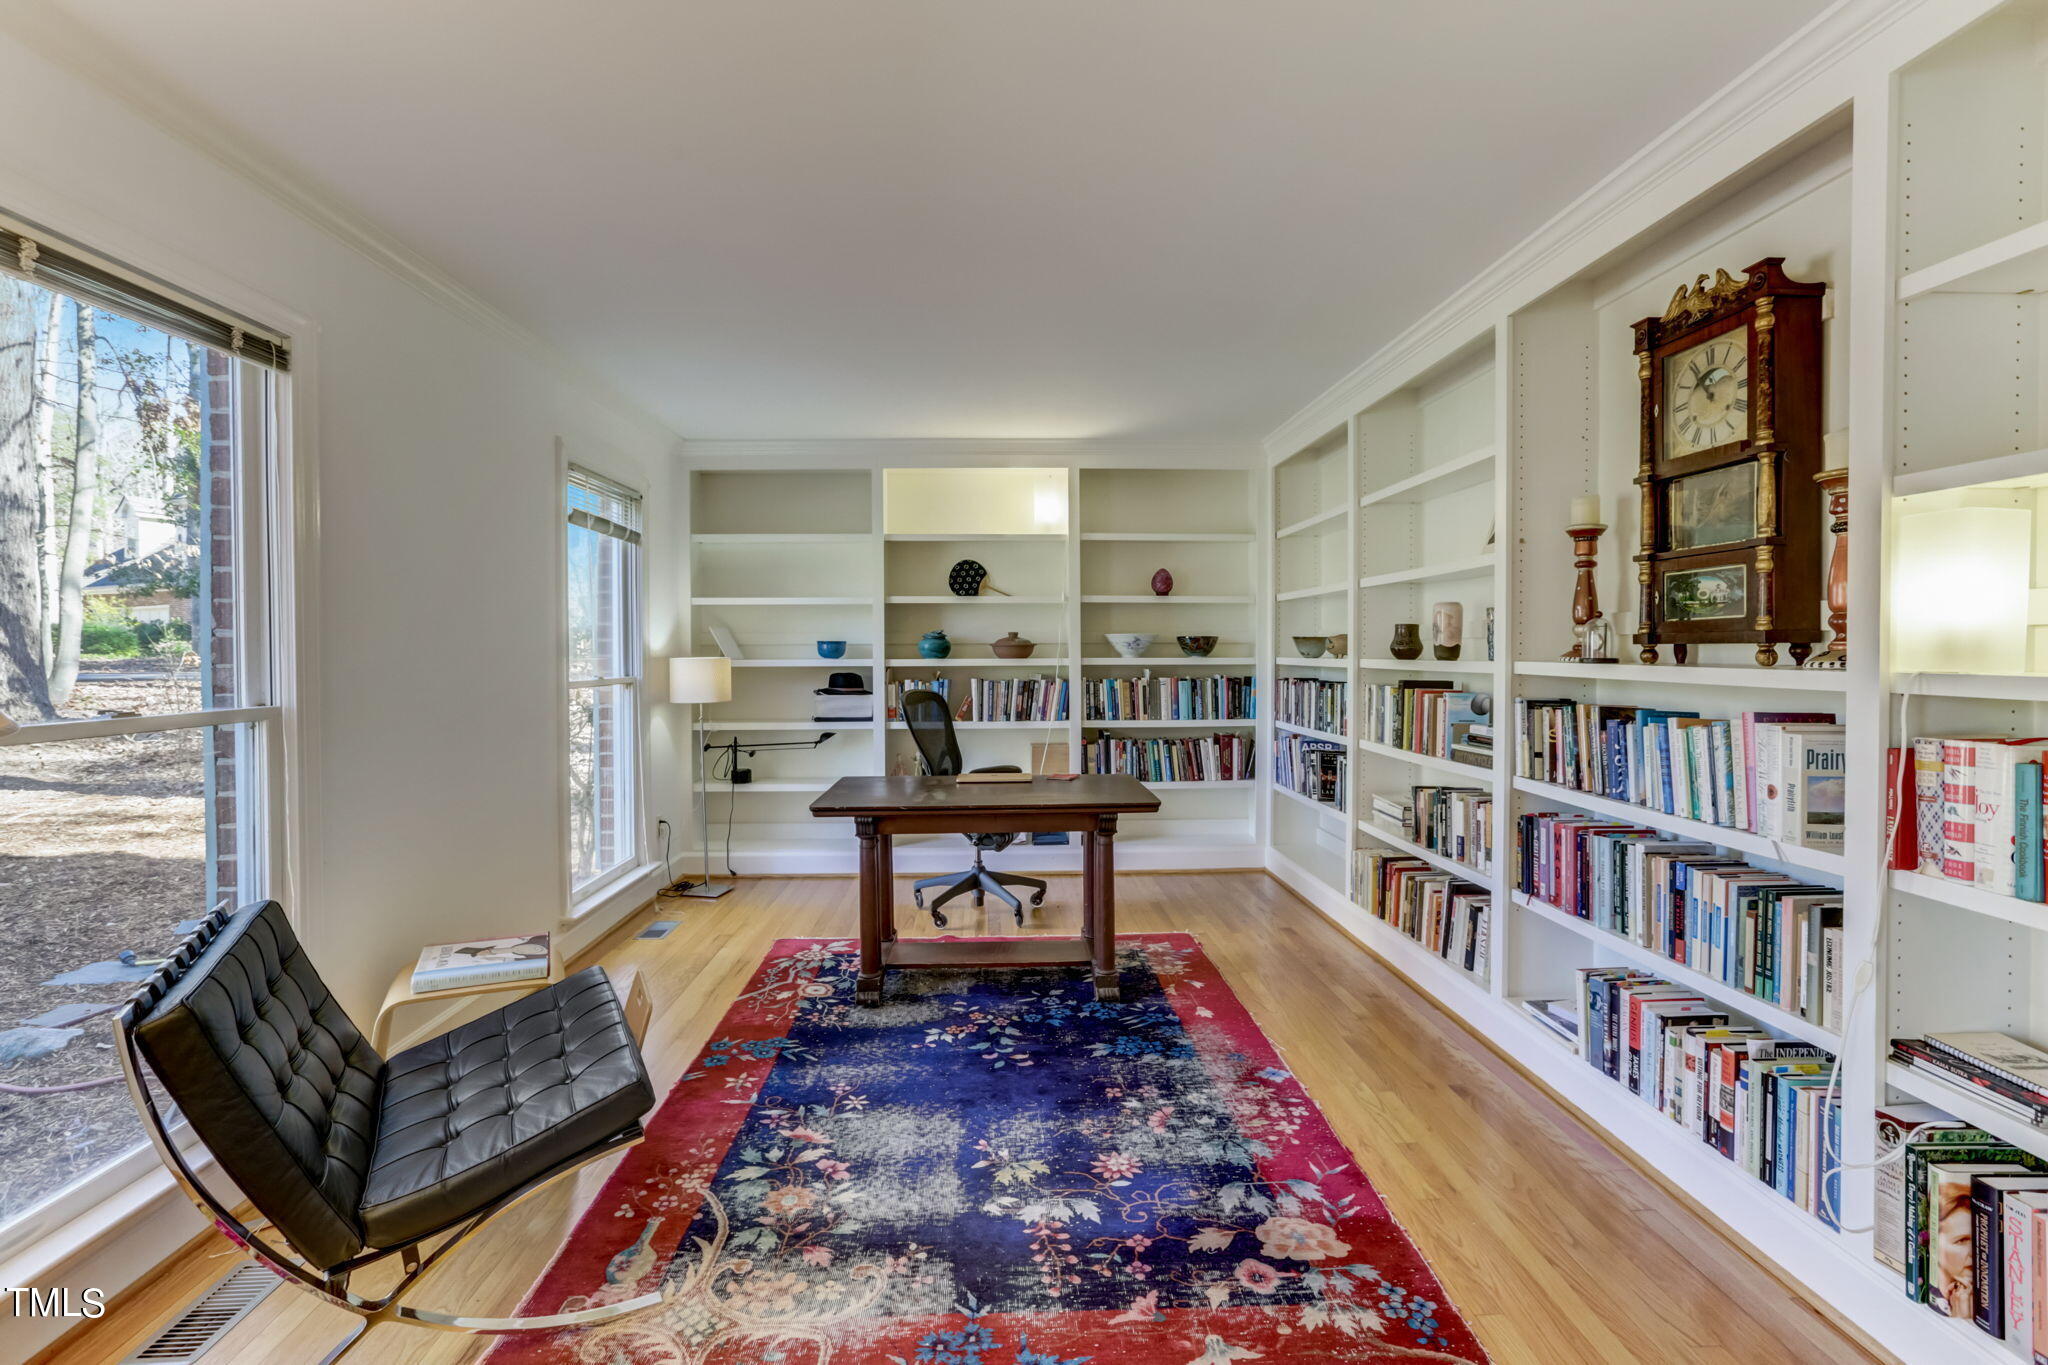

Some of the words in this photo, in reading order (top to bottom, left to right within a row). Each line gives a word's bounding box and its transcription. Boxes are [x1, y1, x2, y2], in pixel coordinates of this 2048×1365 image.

[2020, 799, 2028, 811] The
[2019, 813, 2028, 840] Finnish
[2018, 842, 2028, 878] Cookbook
[1760, 1048, 1773, 1058] The
[1932, 1058, 1950, 1071] KAMA
[1950, 1066, 1968, 1079] SUTRA
[1907, 1205, 1915, 1228] Making
[1980, 1213, 1989, 1251] PROPHET
[1980, 1261, 1989, 1310] INNOVATION
[2008, 1216, 2025, 1331] STANLEY
